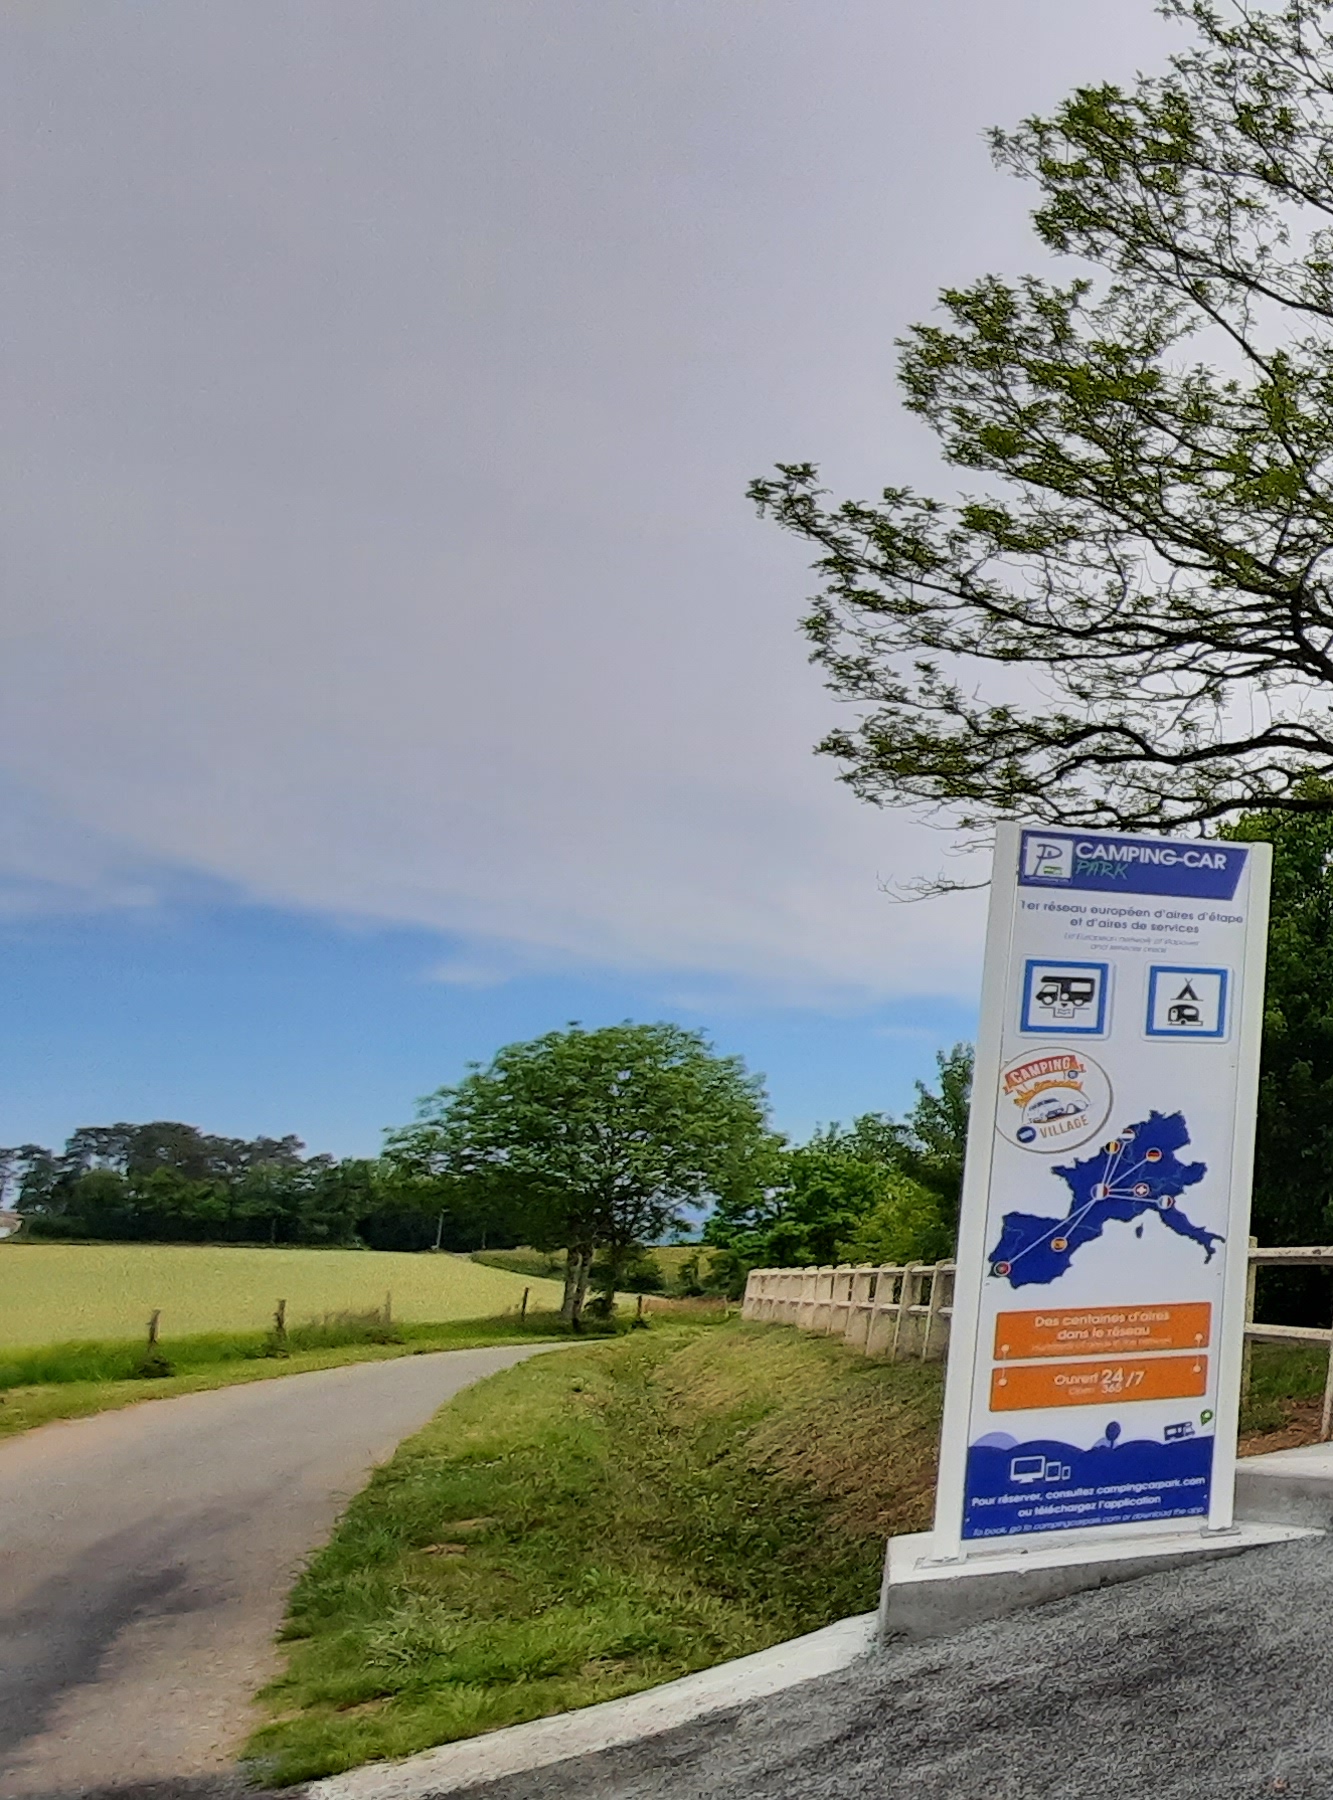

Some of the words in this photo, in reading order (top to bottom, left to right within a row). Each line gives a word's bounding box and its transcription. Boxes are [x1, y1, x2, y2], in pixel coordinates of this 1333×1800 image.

[1075, 842, 1227, 870] CAMPING-CAR
[1075, 859, 1129, 880] PARK
[1021, 900, 1040, 911] 1er
[1043, 901, 1087, 914] réseau
[1090, 905, 1150, 918] européen
[1153, 908, 1194, 920] d'aires
[1197, 911, 1244, 924] d'étape
[1070, 918, 1082, 926] et
[1085, 918, 1128, 929] d'aires
[1131, 921, 1147, 930] de
[1150, 923, 1200, 934] services
[1009, 1056, 1072, 1084] CAMPING
[1039, 1114, 1089, 1139] VILLAGE
[1034, 1316, 1060, 1328] Des
[1062, 1313, 1126, 1326] centaines
[1127, 1310, 1170, 1323] d'aires
[1057, 1328, 1089, 1341] dans
[1092, 1326, 1104, 1338] le
[1107, 1325, 1151, 1337] réseau
[1053, 1372, 1099, 1386] Ouvert
[1101, 1367, 1124, 1384] 24
[1101, 1382, 1123, 1394] 365
[971, 1496, 996, 1507] Pour
[1045, 1487, 1094, 1500] consultez
[1096, 1476, 1206, 1495] campingcarpark.com
[1018, 1508, 1033, 1518] ou
[1034, 1500, 1097, 1515] téléchargez
[1098, 1495, 1162, 1510] l'application
